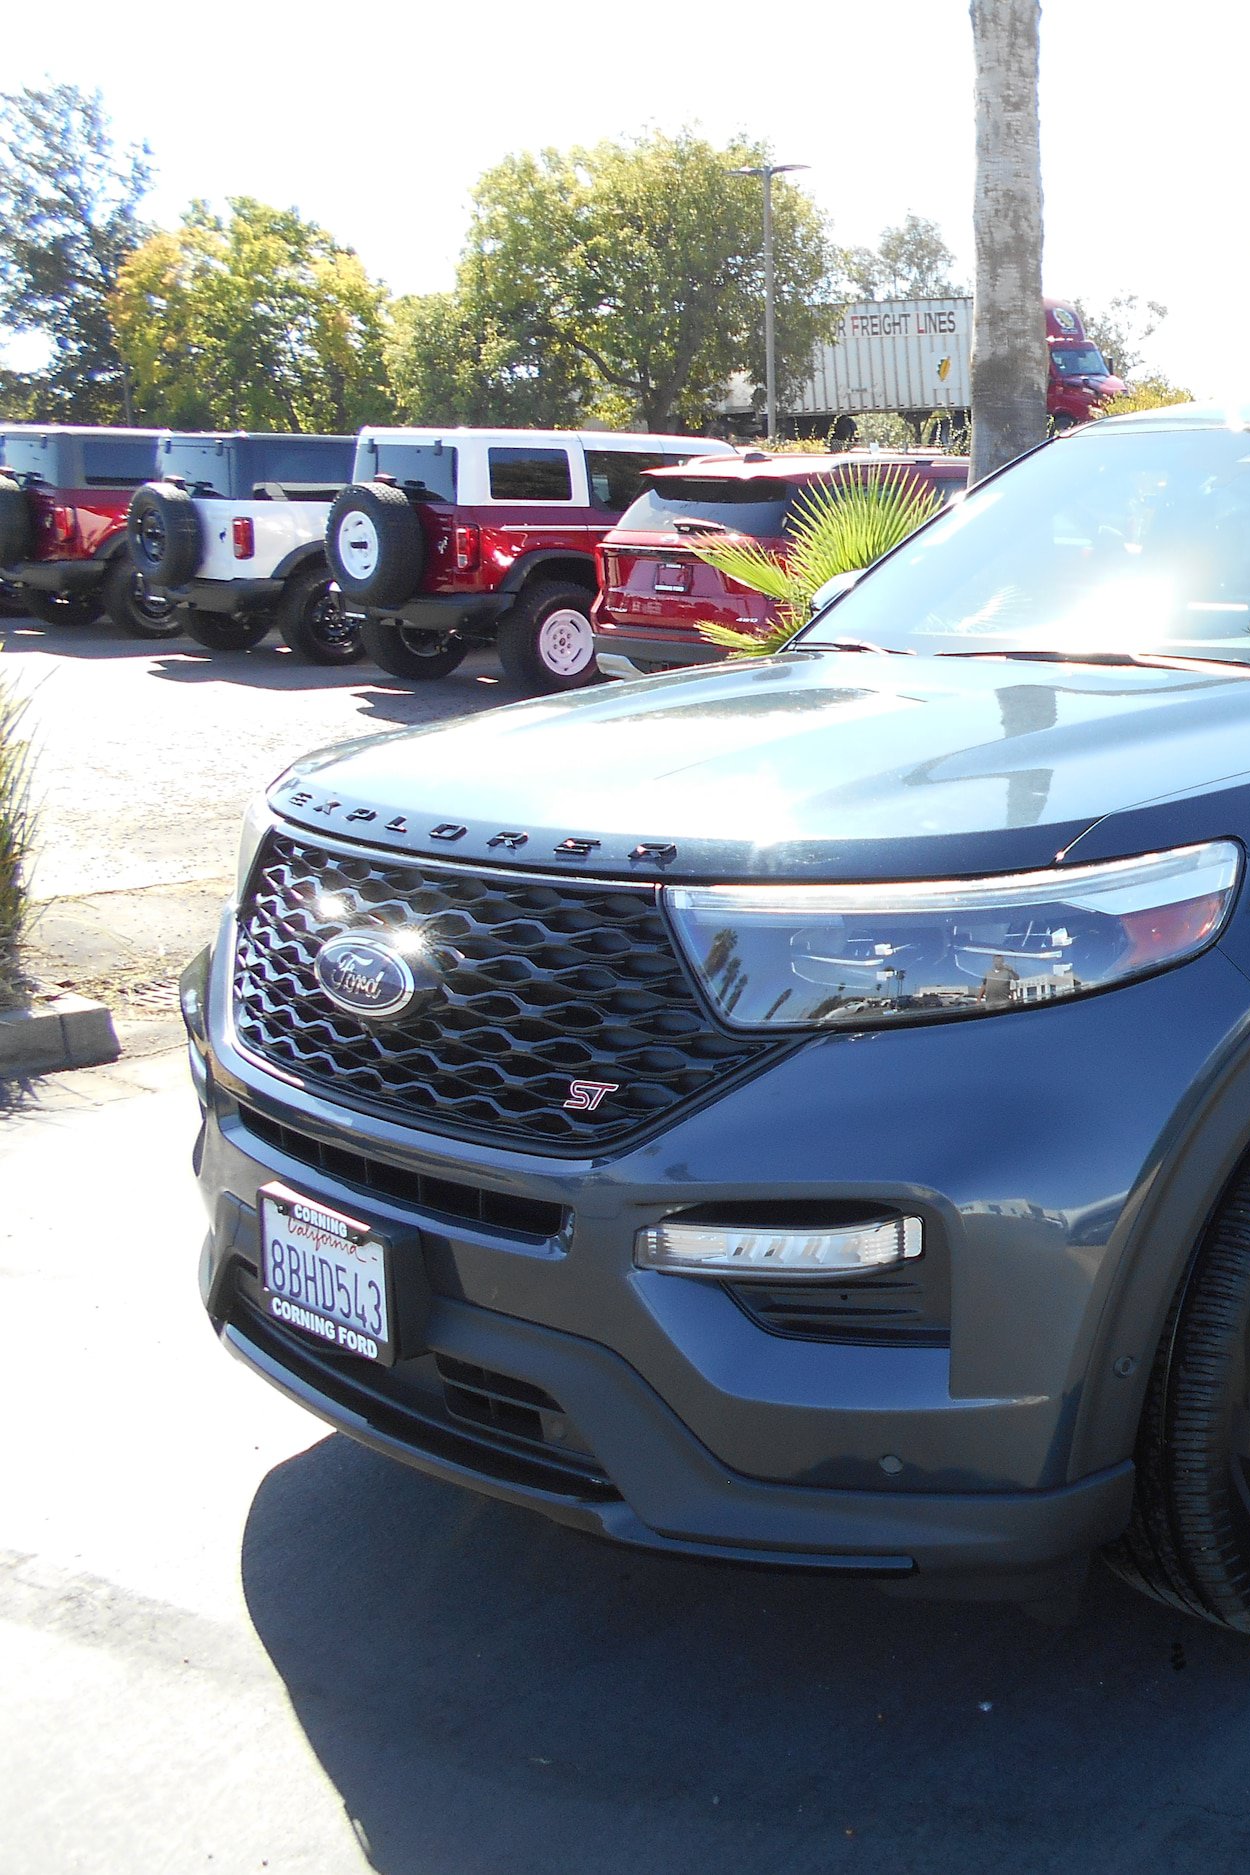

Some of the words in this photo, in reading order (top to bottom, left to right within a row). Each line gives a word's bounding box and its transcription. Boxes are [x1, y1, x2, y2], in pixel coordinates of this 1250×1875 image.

[851, 313, 911, 337] FREIGHT
[917, 311, 957, 334] LINES
[288, 791, 679, 870] EXPLORER
[331, 951, 383, 1002] Ford
[562, 1078, 619, 1111] ST
[286, 1217, 368, 1263] California
[294, 1204, 348, 1238] CORNING
[271, 1238, 382, 1336] 8BHD543
[272, 1297, 336, 1339] CORNING
[338, 1326, 378, 1360] FORD
